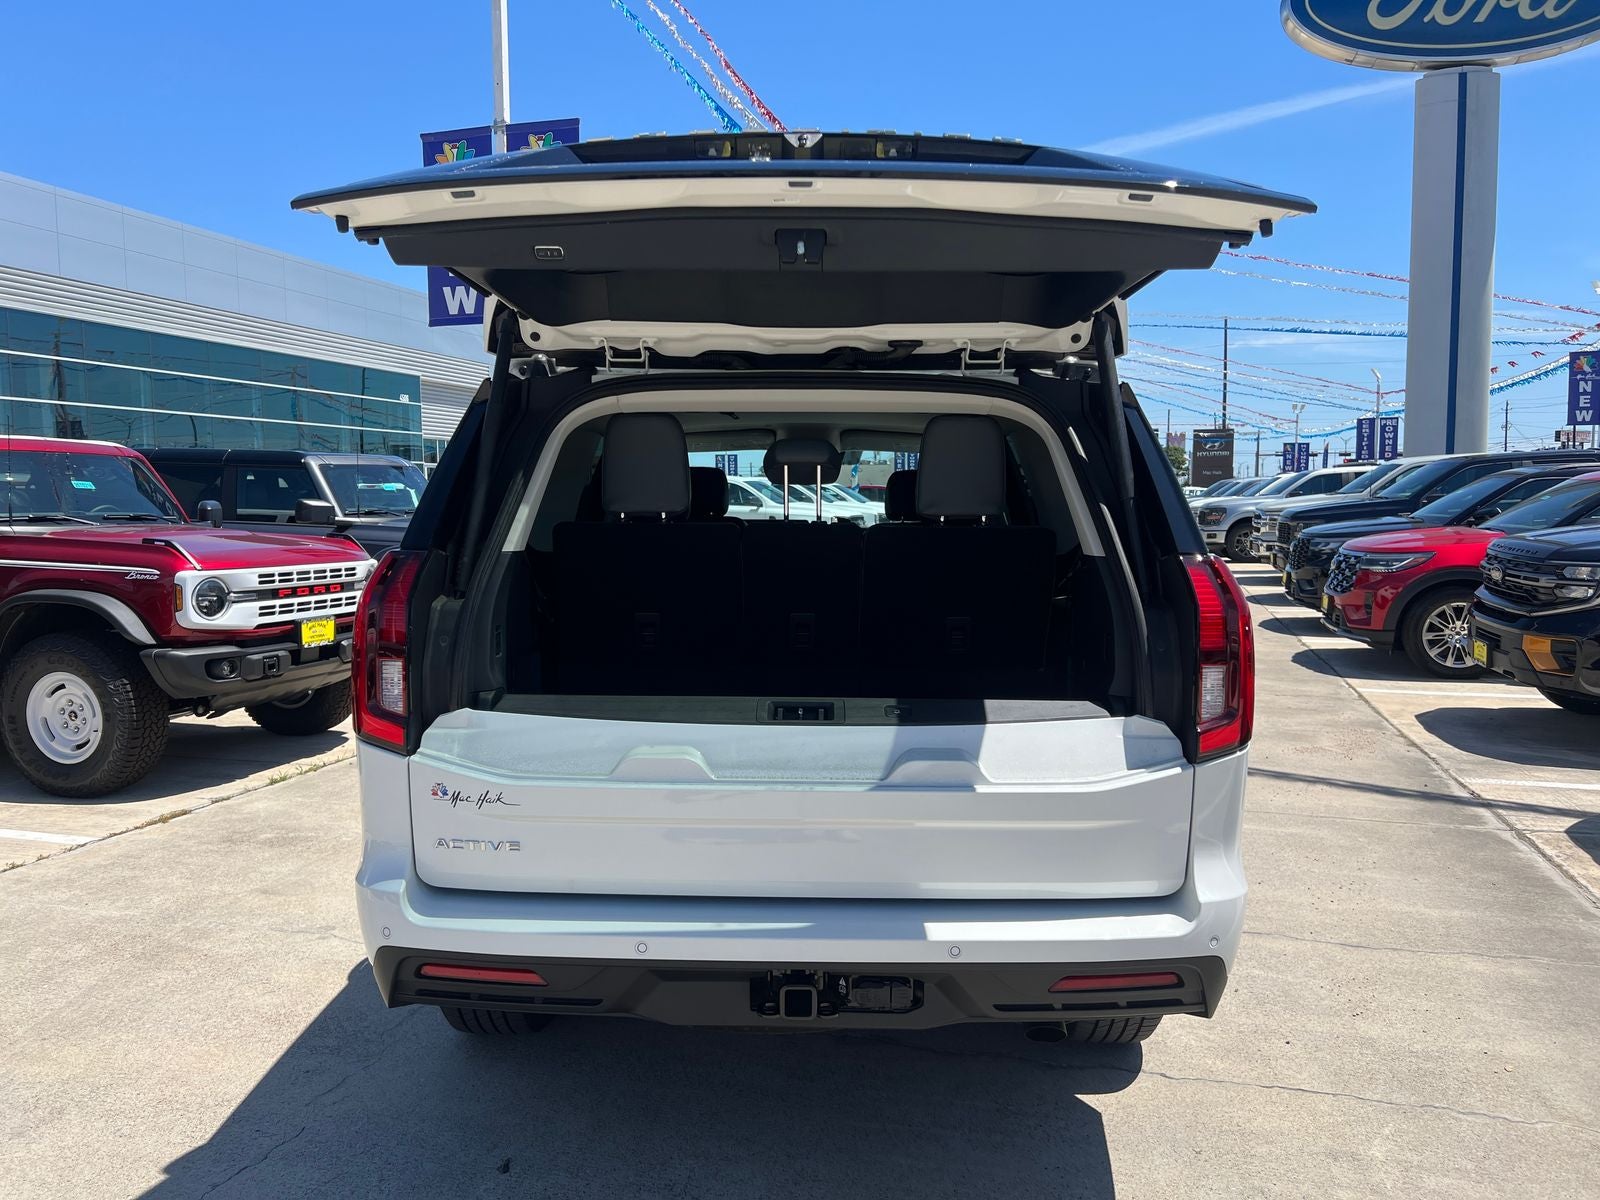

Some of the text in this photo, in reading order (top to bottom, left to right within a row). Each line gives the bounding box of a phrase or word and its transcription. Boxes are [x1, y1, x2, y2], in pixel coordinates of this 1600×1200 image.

[1575, 380, 1594, 422] NEW
[1361, 419, 1370, 459] CERTIFIED
[1384, 426, 1395, 458] OWNED
[1284, 454, 1293, 471] NEW
[124, 570, 160, 580] Bronco
[278, 584, 341, 597] FORD
[449, 790, 520, 809] Mac Haik
[434, 837, 521, 852] ACTIVE
